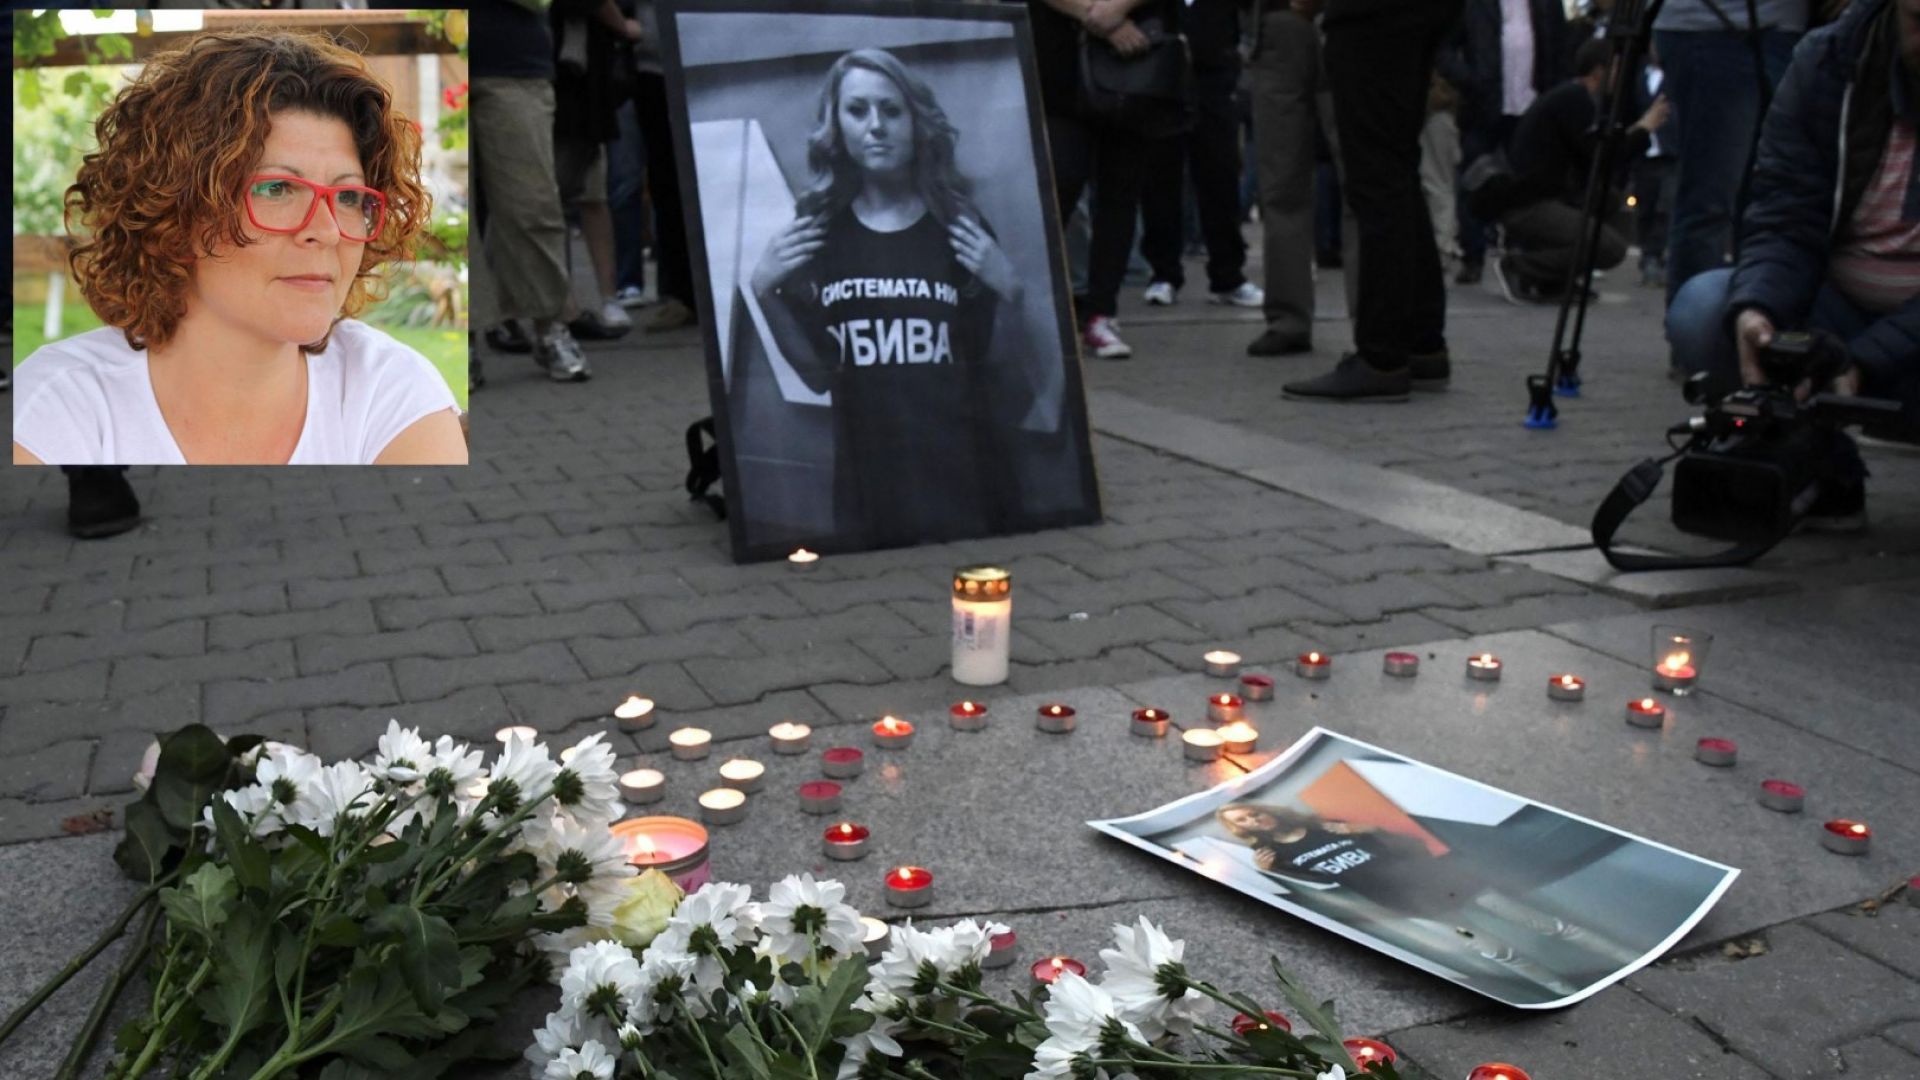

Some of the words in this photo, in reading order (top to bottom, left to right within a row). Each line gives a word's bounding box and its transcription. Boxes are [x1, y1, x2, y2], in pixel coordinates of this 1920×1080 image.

[822, 278, 931, 306] СИСТЕМАТА
[935, 281, 958, 306] НИ
[826, 318, 953, 367] УБИВА
